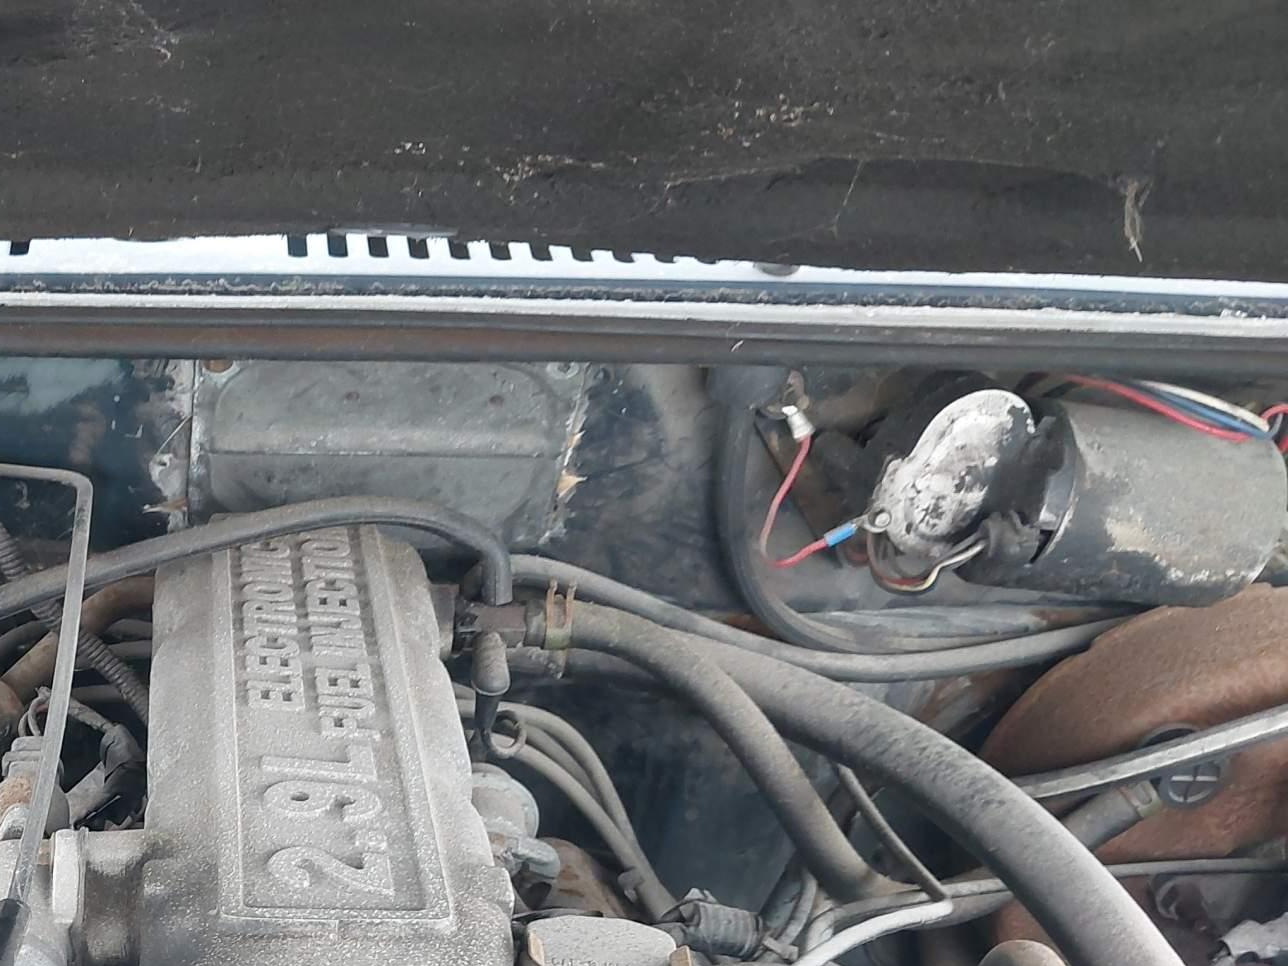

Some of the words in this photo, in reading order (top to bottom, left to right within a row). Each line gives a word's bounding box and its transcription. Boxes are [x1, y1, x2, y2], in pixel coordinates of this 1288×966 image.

[240, 535, 306, 712] ELECTRONIC
[314, 664, 381, 741] FUEL
[259, 740, 395, 899] 2.9L
